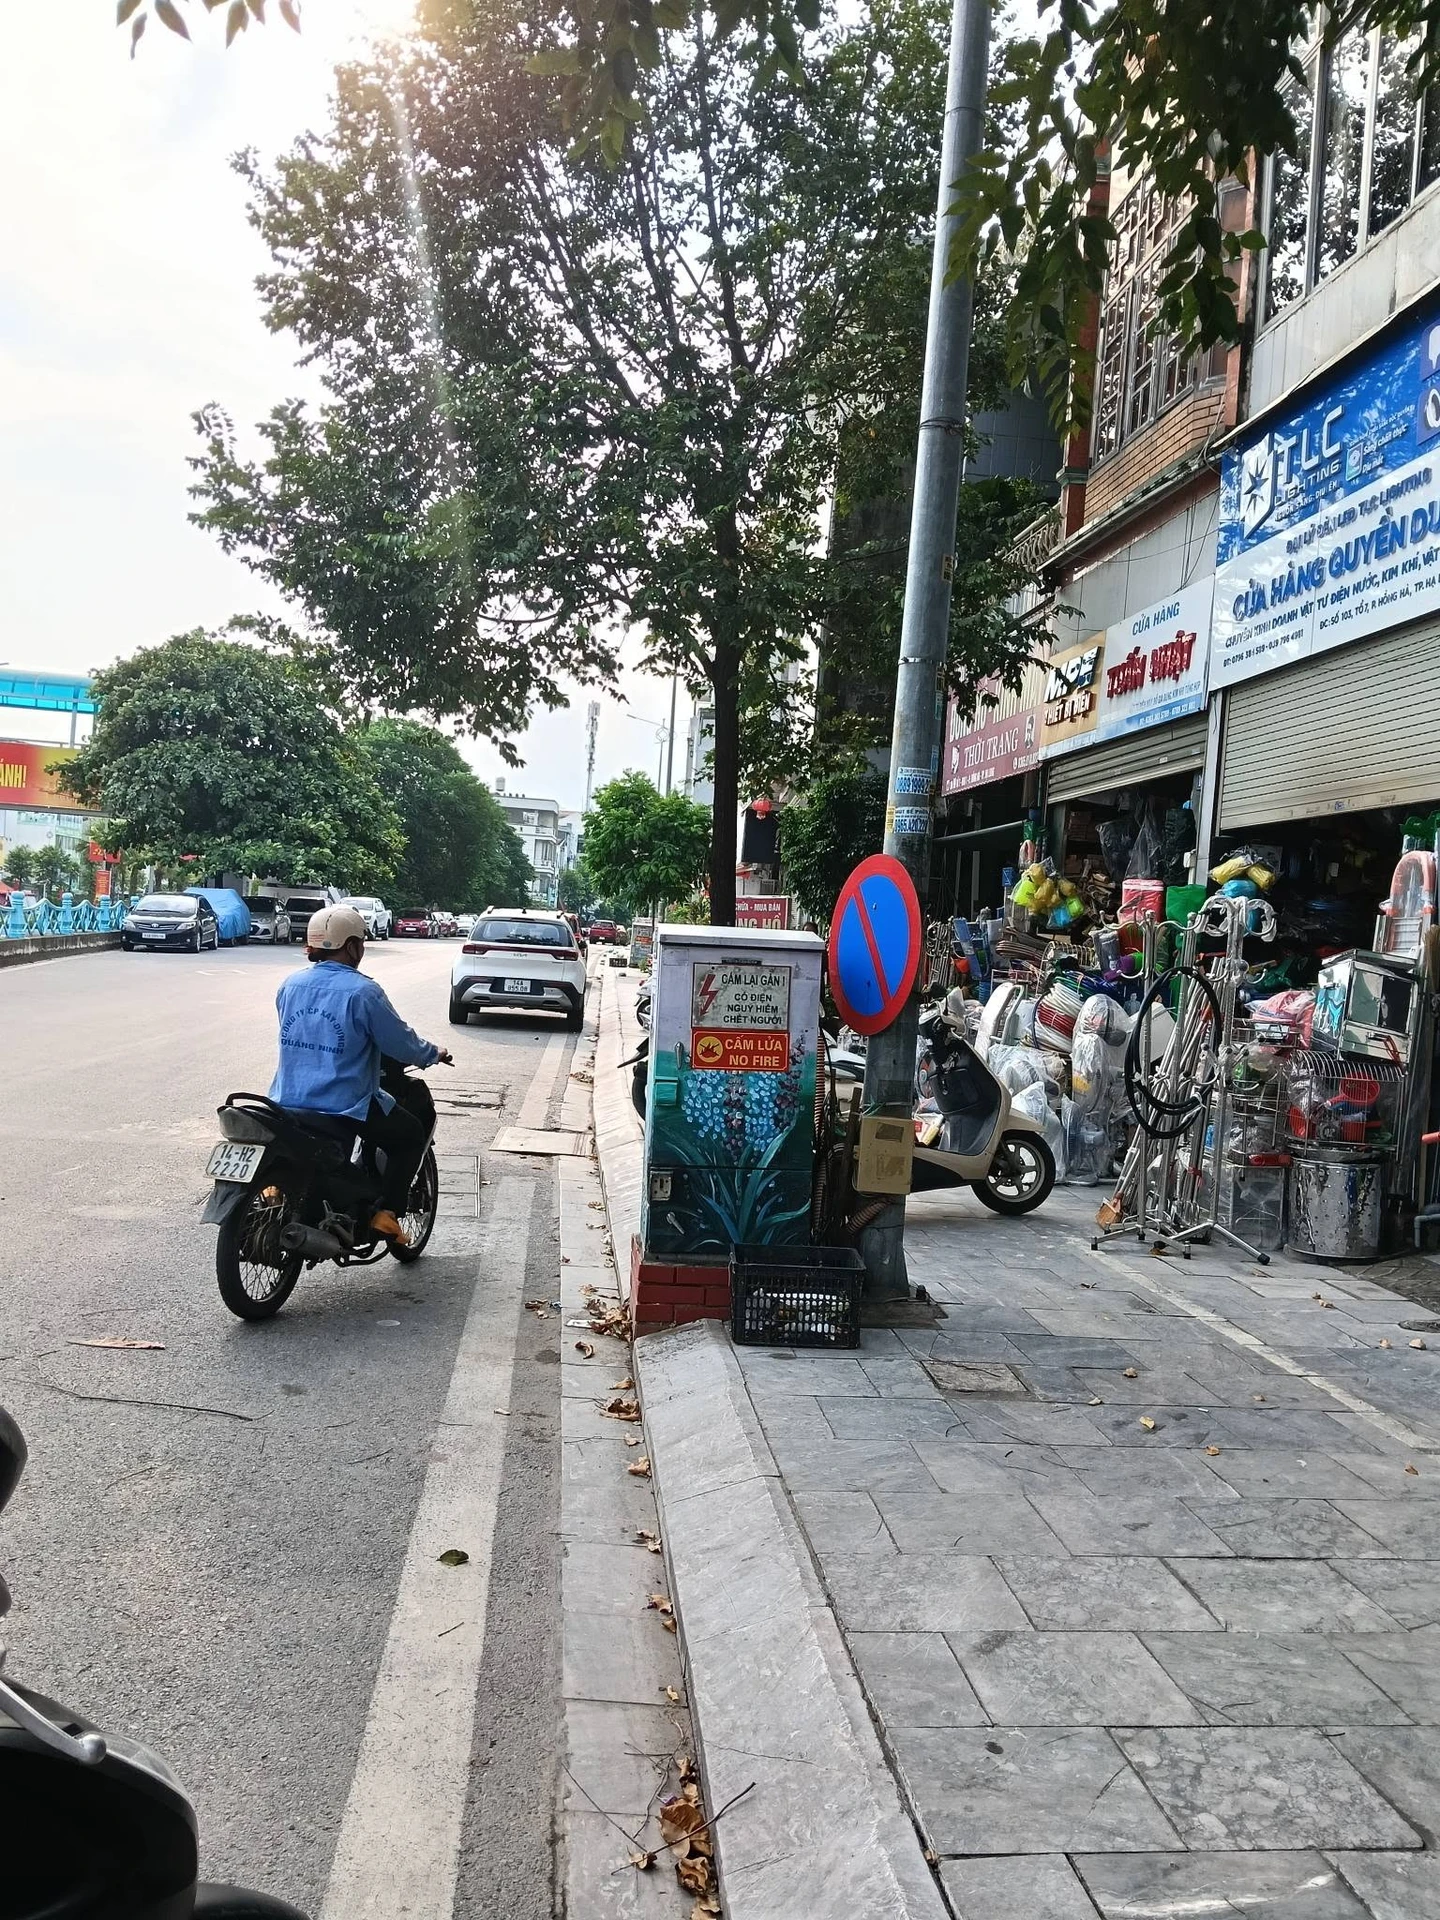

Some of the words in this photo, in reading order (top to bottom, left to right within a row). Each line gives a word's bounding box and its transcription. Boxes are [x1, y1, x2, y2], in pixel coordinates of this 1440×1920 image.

[1277, 404, 1344, 484] TLC
[1274, 459, 1341, 507] LIGHTING
[1232, 578, 1268, 621] CỬA
[1270, 560, 1326, 607] HÀNG
[1328, 506, 1409, 579] QUYỀN
[1271, 607, 1298, 630] DOANH
[1300, 600, 1314, 618] VẬT
[1317, 595, 1329, 611] TƯ
[1329, 583, 1351, 606] ĐIỆN
[1382, 564, 1399, 583] KIM
[1378, 589, 1398, 608] HỒNG
[1132, 613, 1150, 635] CỬA
[1153, 601, 1180, 627] HÀNG
[963, 736, 985, 769] THỜI
[986, 728, 1019, 761] TRANG
[754, 903, 767, 912] MUA
[768, 902, 781, 912] BÁN
[744, 973, 759, 988] LẠI
[734, 991, 749, 1002] CÓ
[750, 993, 772, 1004] ĐIỆN
[296, 1008, 305, 1017] TY
[727, 1004, 754, 1013] NGUY
[755, 1004, 779, 1014] HIỂM
[723, 1013, 749, 1024] CHẾT
[750, 1014, 782, 1025] NGƯỜI
[318, 1044, 344, 1054] NINH
[725, 1034, 754, 1050] CẤM
[757, 1035, 783, 1052] LỬA
[729, 1055, 749, 1066] NO
[752, 1055, 780, 1067] FIRE
[220, 1144, 256, 1162] 14-H2
[210, 1160, 249, 1178] 2220
